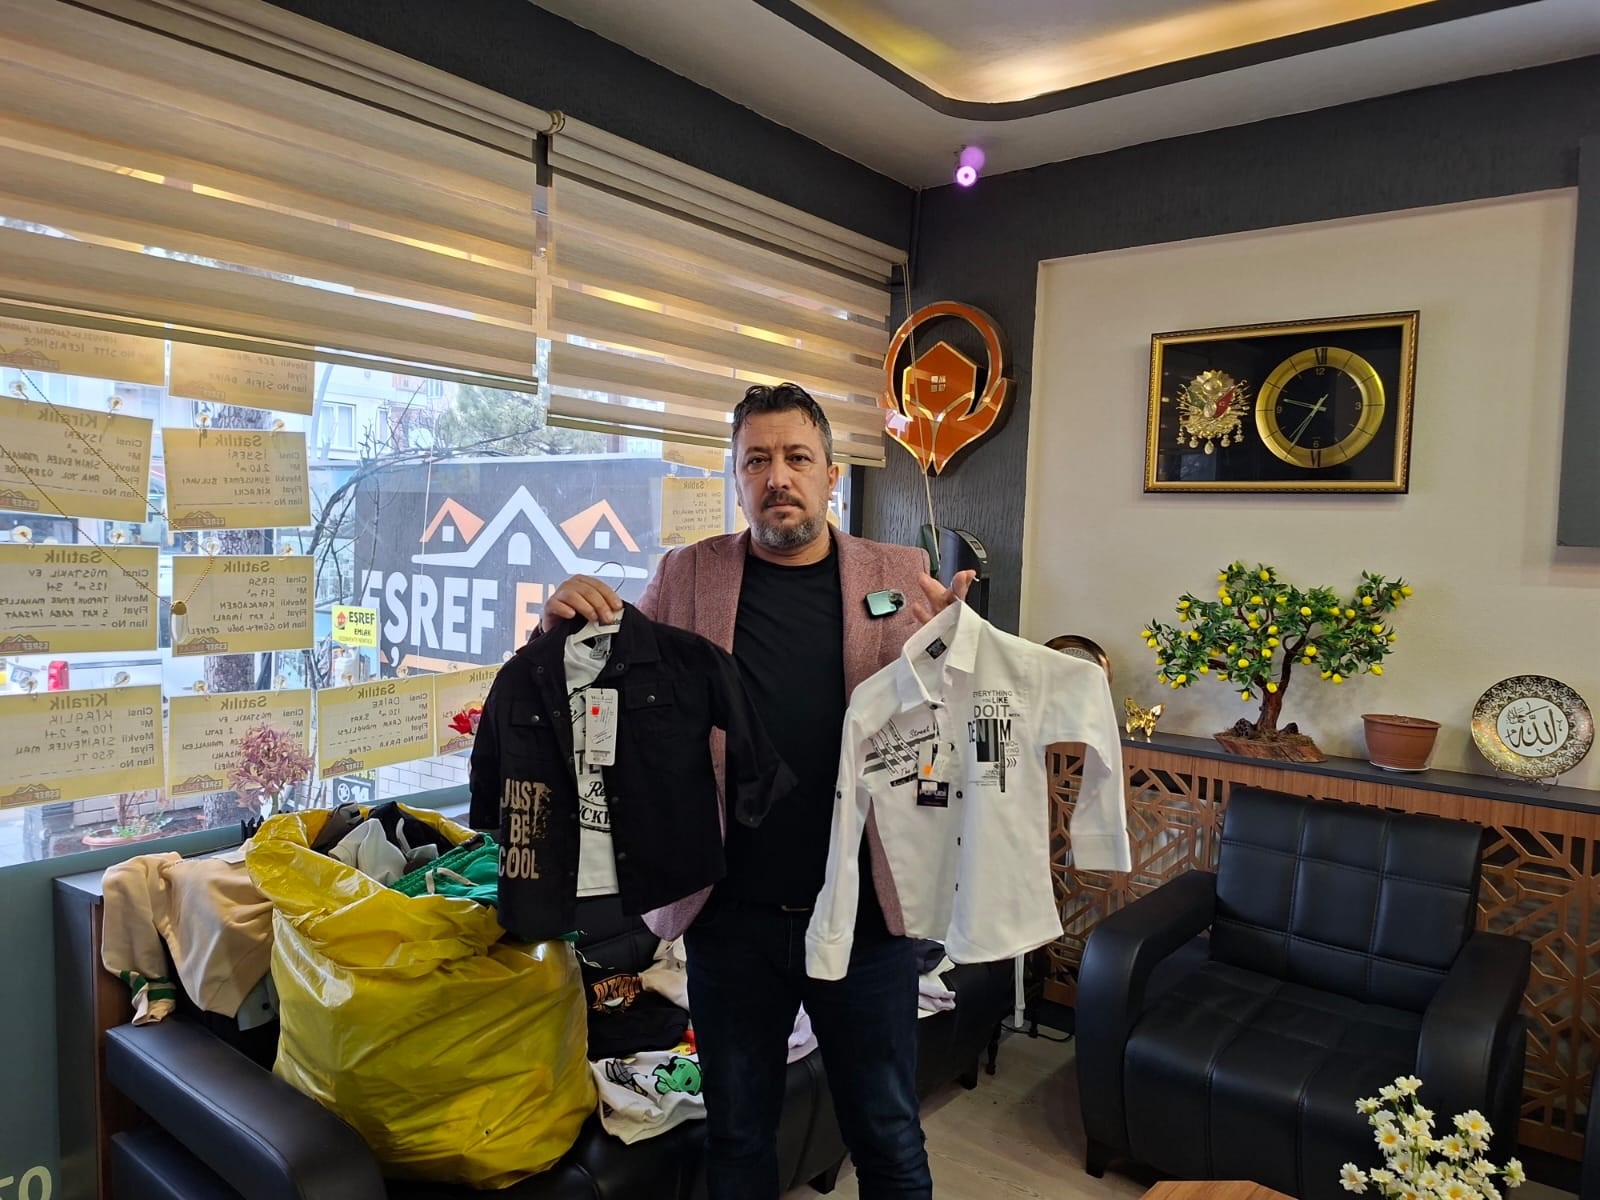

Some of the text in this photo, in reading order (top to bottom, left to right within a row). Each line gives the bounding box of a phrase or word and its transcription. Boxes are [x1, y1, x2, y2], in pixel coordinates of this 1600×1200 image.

[1315, 368, 1326, 376] 12
[1276, 406, 1282, 414] 9
[1355, 402, 1362, 410] 3
[1312, 440, 1320, 448] 6
[348, 611, 376, 626] EŞREF
[992, 696, 1009, 704] LIKE
[500, 778, 548, 812] JUST
[510, 812, 530, 846] BE
[498, 846, 540, 880] COOL
